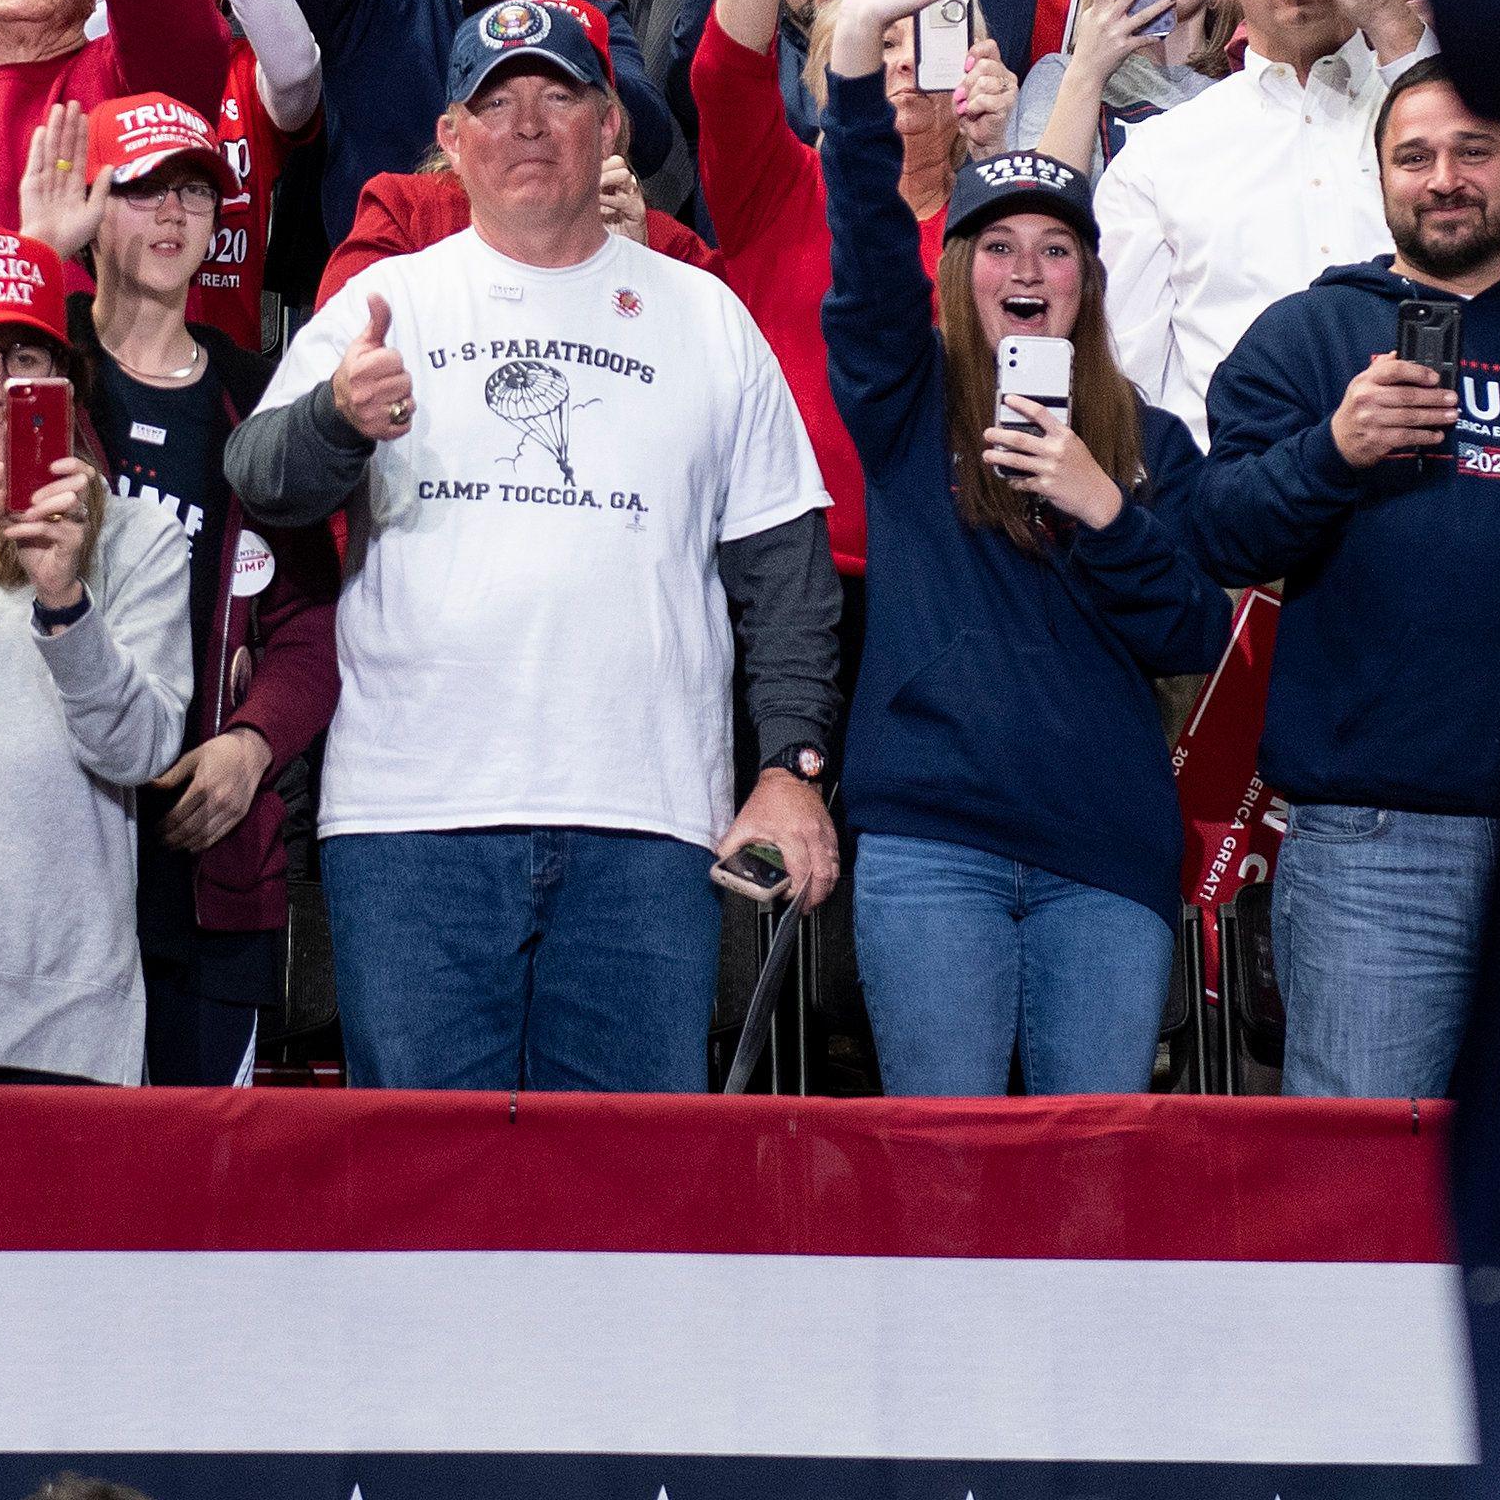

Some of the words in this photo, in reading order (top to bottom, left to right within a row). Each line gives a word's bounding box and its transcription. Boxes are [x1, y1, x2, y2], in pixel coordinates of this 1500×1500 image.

[115, 103, 209, 132] TRUMP
[975, 156, 1074, 181] TRUMP
[490, 338, 657, 386] PARATROOPS
[418, 479, 491, 503] CAMP
[497, 483, 604, 511] TOCCOA,
[610, 490, 650, 514] GA.
[1202, 836, 1238, 901] GREAT!
